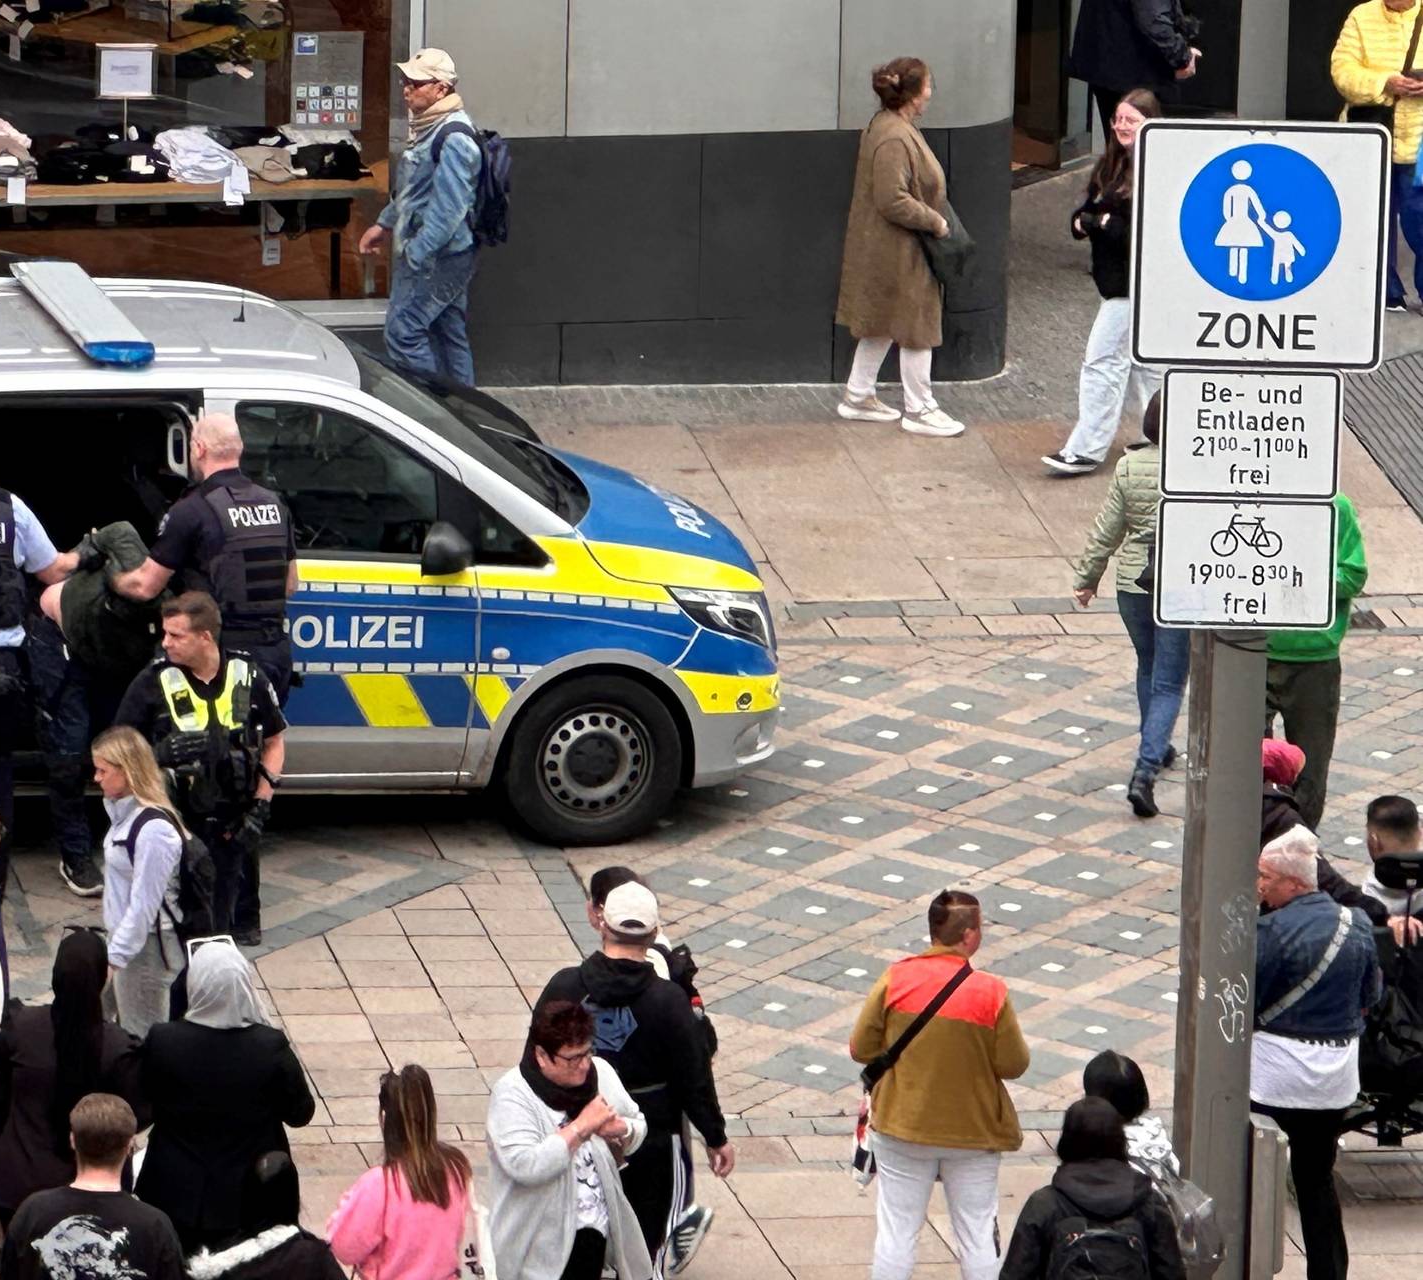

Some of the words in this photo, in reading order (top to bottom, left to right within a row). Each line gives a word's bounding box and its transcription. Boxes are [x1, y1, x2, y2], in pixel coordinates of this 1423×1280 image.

[1196, 312, 1318, 350] ZONE
[1201, 381, 1246, 403] Be-
[1258, 384, 1303, 404] und
[1197, 409, 1306, 432] Entladen
[1229, 463, 1270, 485] frei
[227, 503, 282, 528] POLIZEI
